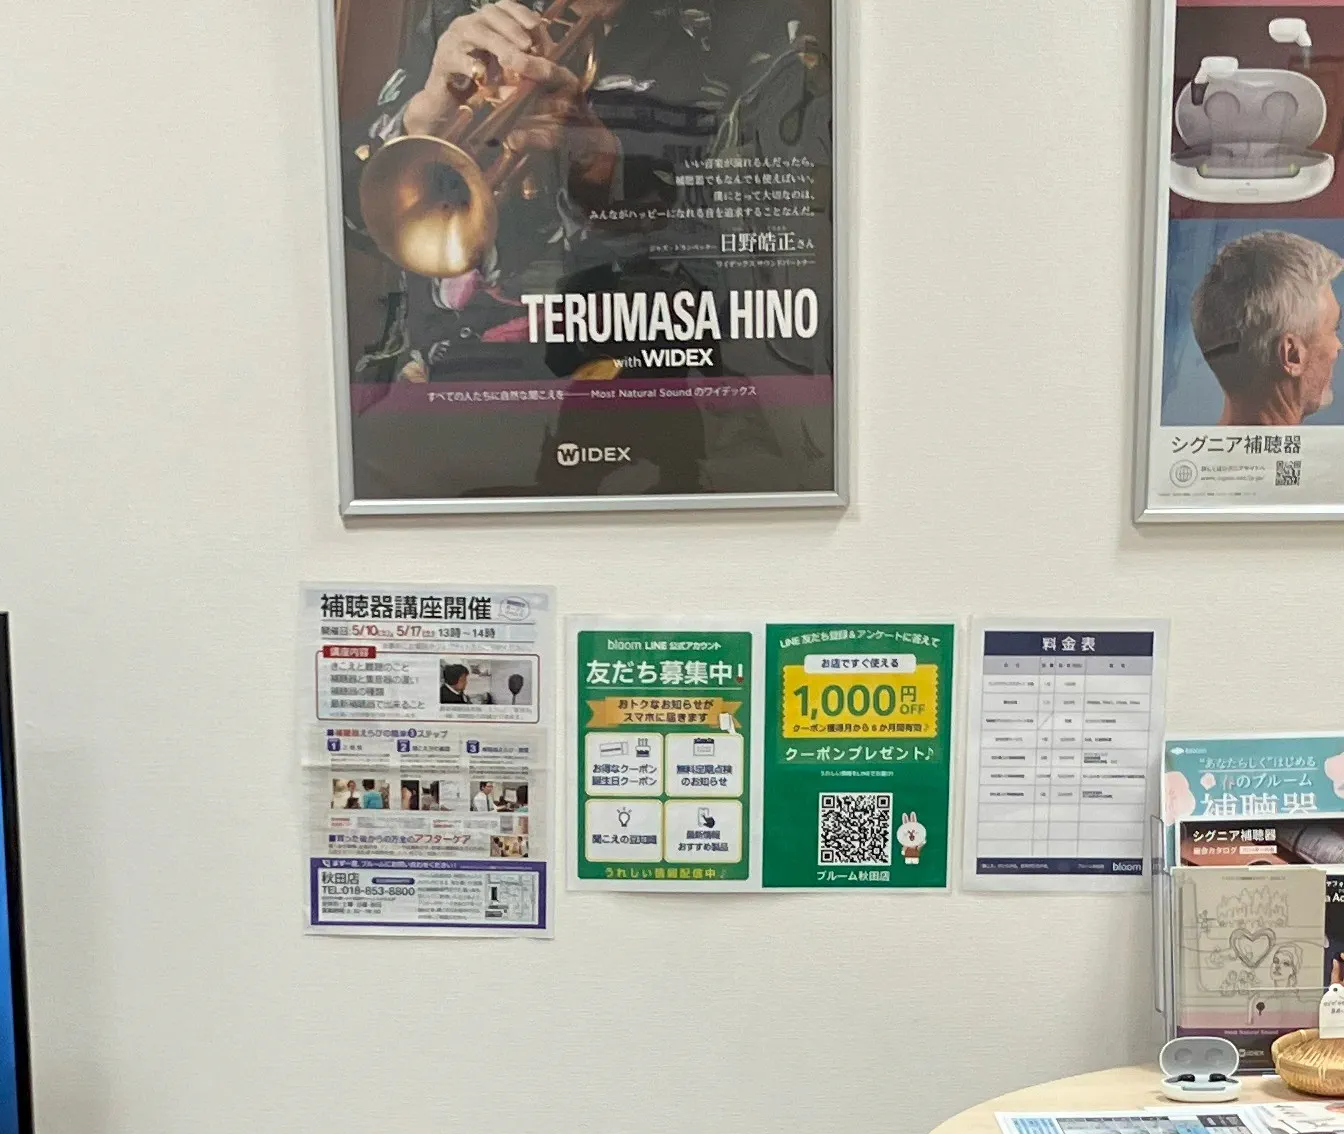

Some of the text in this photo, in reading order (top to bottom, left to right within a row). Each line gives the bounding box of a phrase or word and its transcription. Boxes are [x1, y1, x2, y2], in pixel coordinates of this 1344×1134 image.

[521, 288, 819, 343] TERUMASA HINO
[612, 348, 714, 369] with WIDEX
[619, 388, 656, 398] Natural
[659, 387, 693, 398] Sound
[1171, 435, 1301, 454] シグニア補聴器
[557, 443, 631, 467] WIDEX
[321, 593, 492, 620] 補聴器講座開催
[608, 639, 642, 650] bloom
[644, 641, 668, 650] LINE
[1042, 636, 1096, 652] 料金表
[821, 658, 899, 669] お店ですぐ使える
[618, 699, 714, 710] おトクなお知らせが
[793, 684, 917, 721] 1,000 円
[899, 703, 926, 716] OFF
[624, 712, 708, 723] スマホに届きます
[592, 764, 658, 774] お得なクーポン
[592, 776, 658, 786] 誕生日クーポン
[681, 776, 728, 787] のお知らせ
[1192, 829, 1277, 842] シグニア補聴器
[1112, 861, 1143, 872] bloom
[322, 871, 360, 885] 秋田店
[816, 870, 890, 882] ブルーム秋田店
